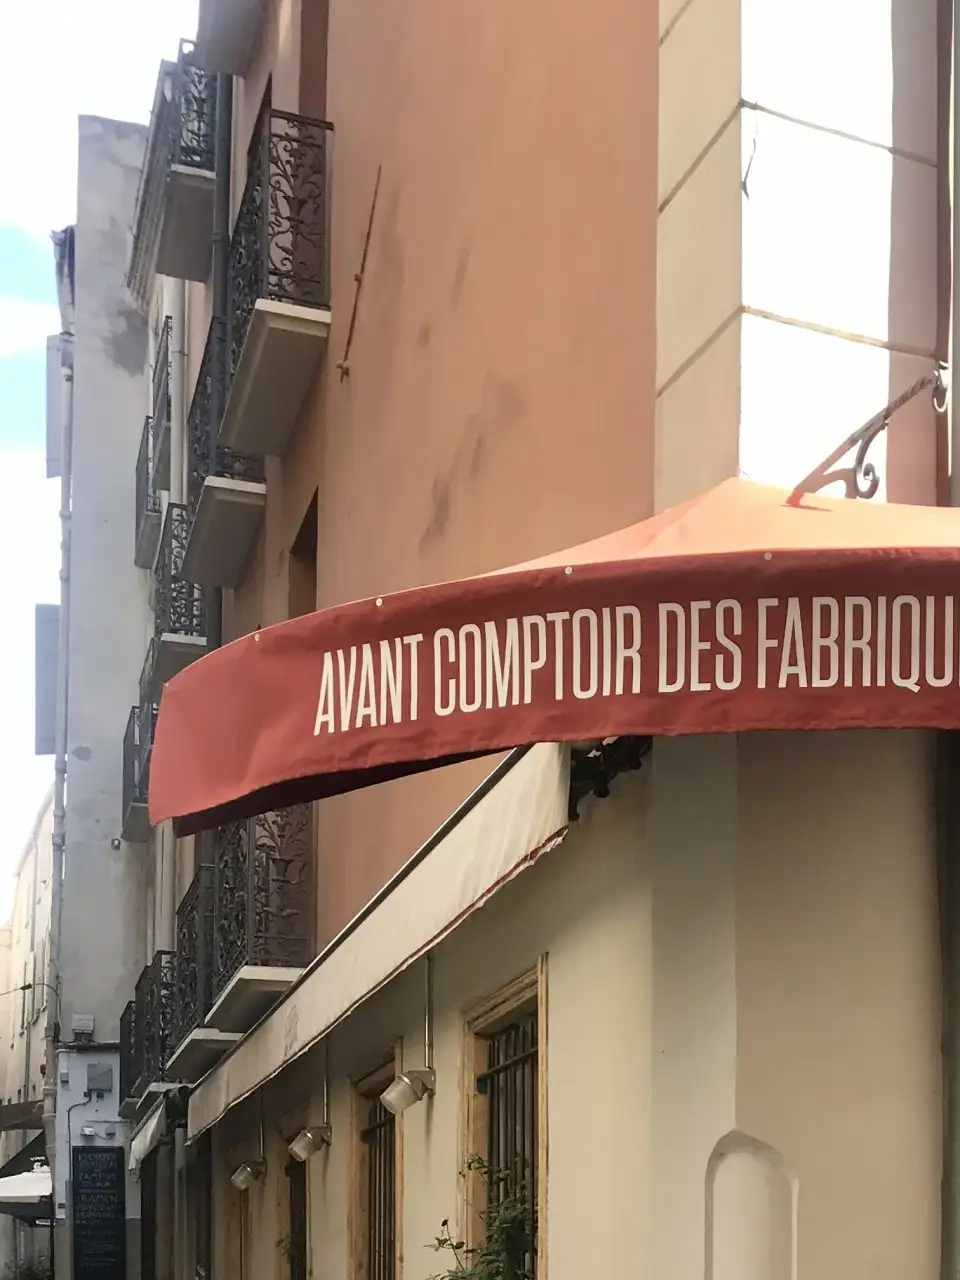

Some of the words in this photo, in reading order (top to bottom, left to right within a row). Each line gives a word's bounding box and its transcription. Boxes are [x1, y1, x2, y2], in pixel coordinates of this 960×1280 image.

[313, 632, 424, 737] AVANT
[432, 604, 642, 718] COMPTOIR
[657, 598, 743, 694] DES
